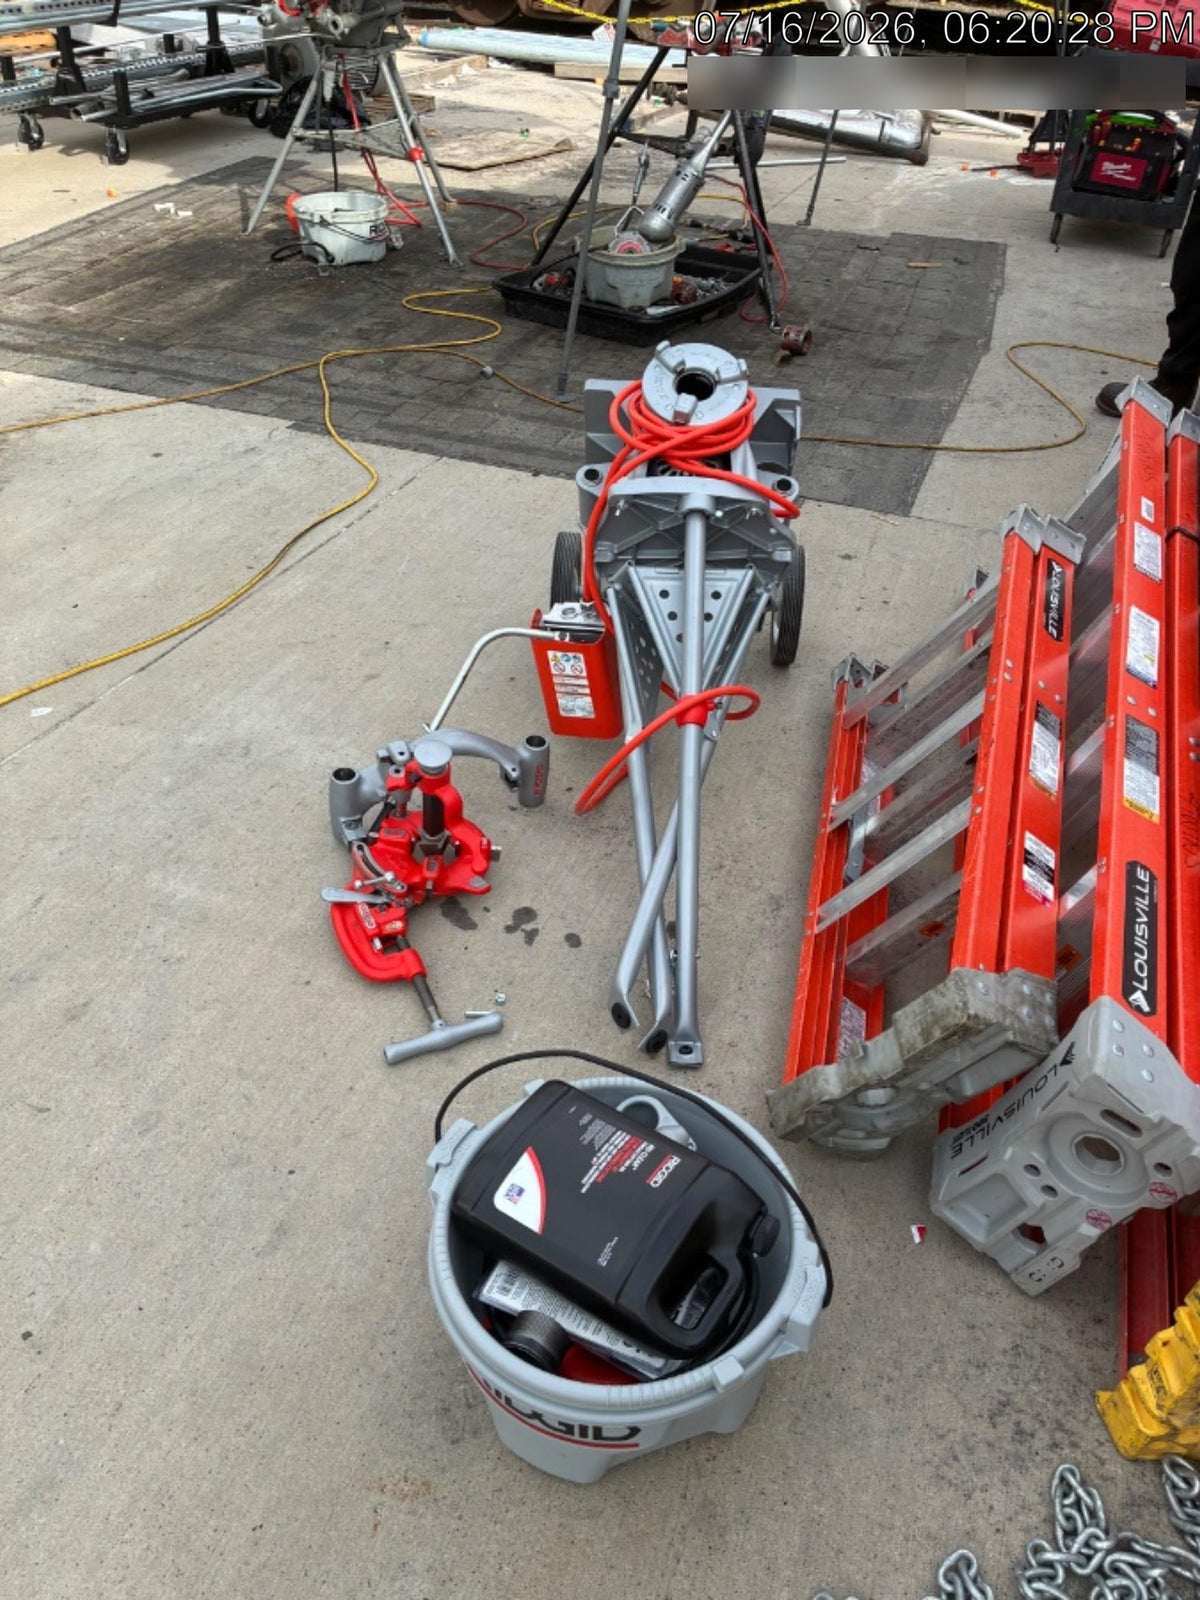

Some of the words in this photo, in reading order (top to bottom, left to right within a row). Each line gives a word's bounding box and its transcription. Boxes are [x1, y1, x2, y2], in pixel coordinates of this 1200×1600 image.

[1047, 571, 1061, 639] LOUISVILLE
[1131, 864, 1151, 990] LOUISVILLE
[949, 1061, 1061, 1160] LOUISVILLE
